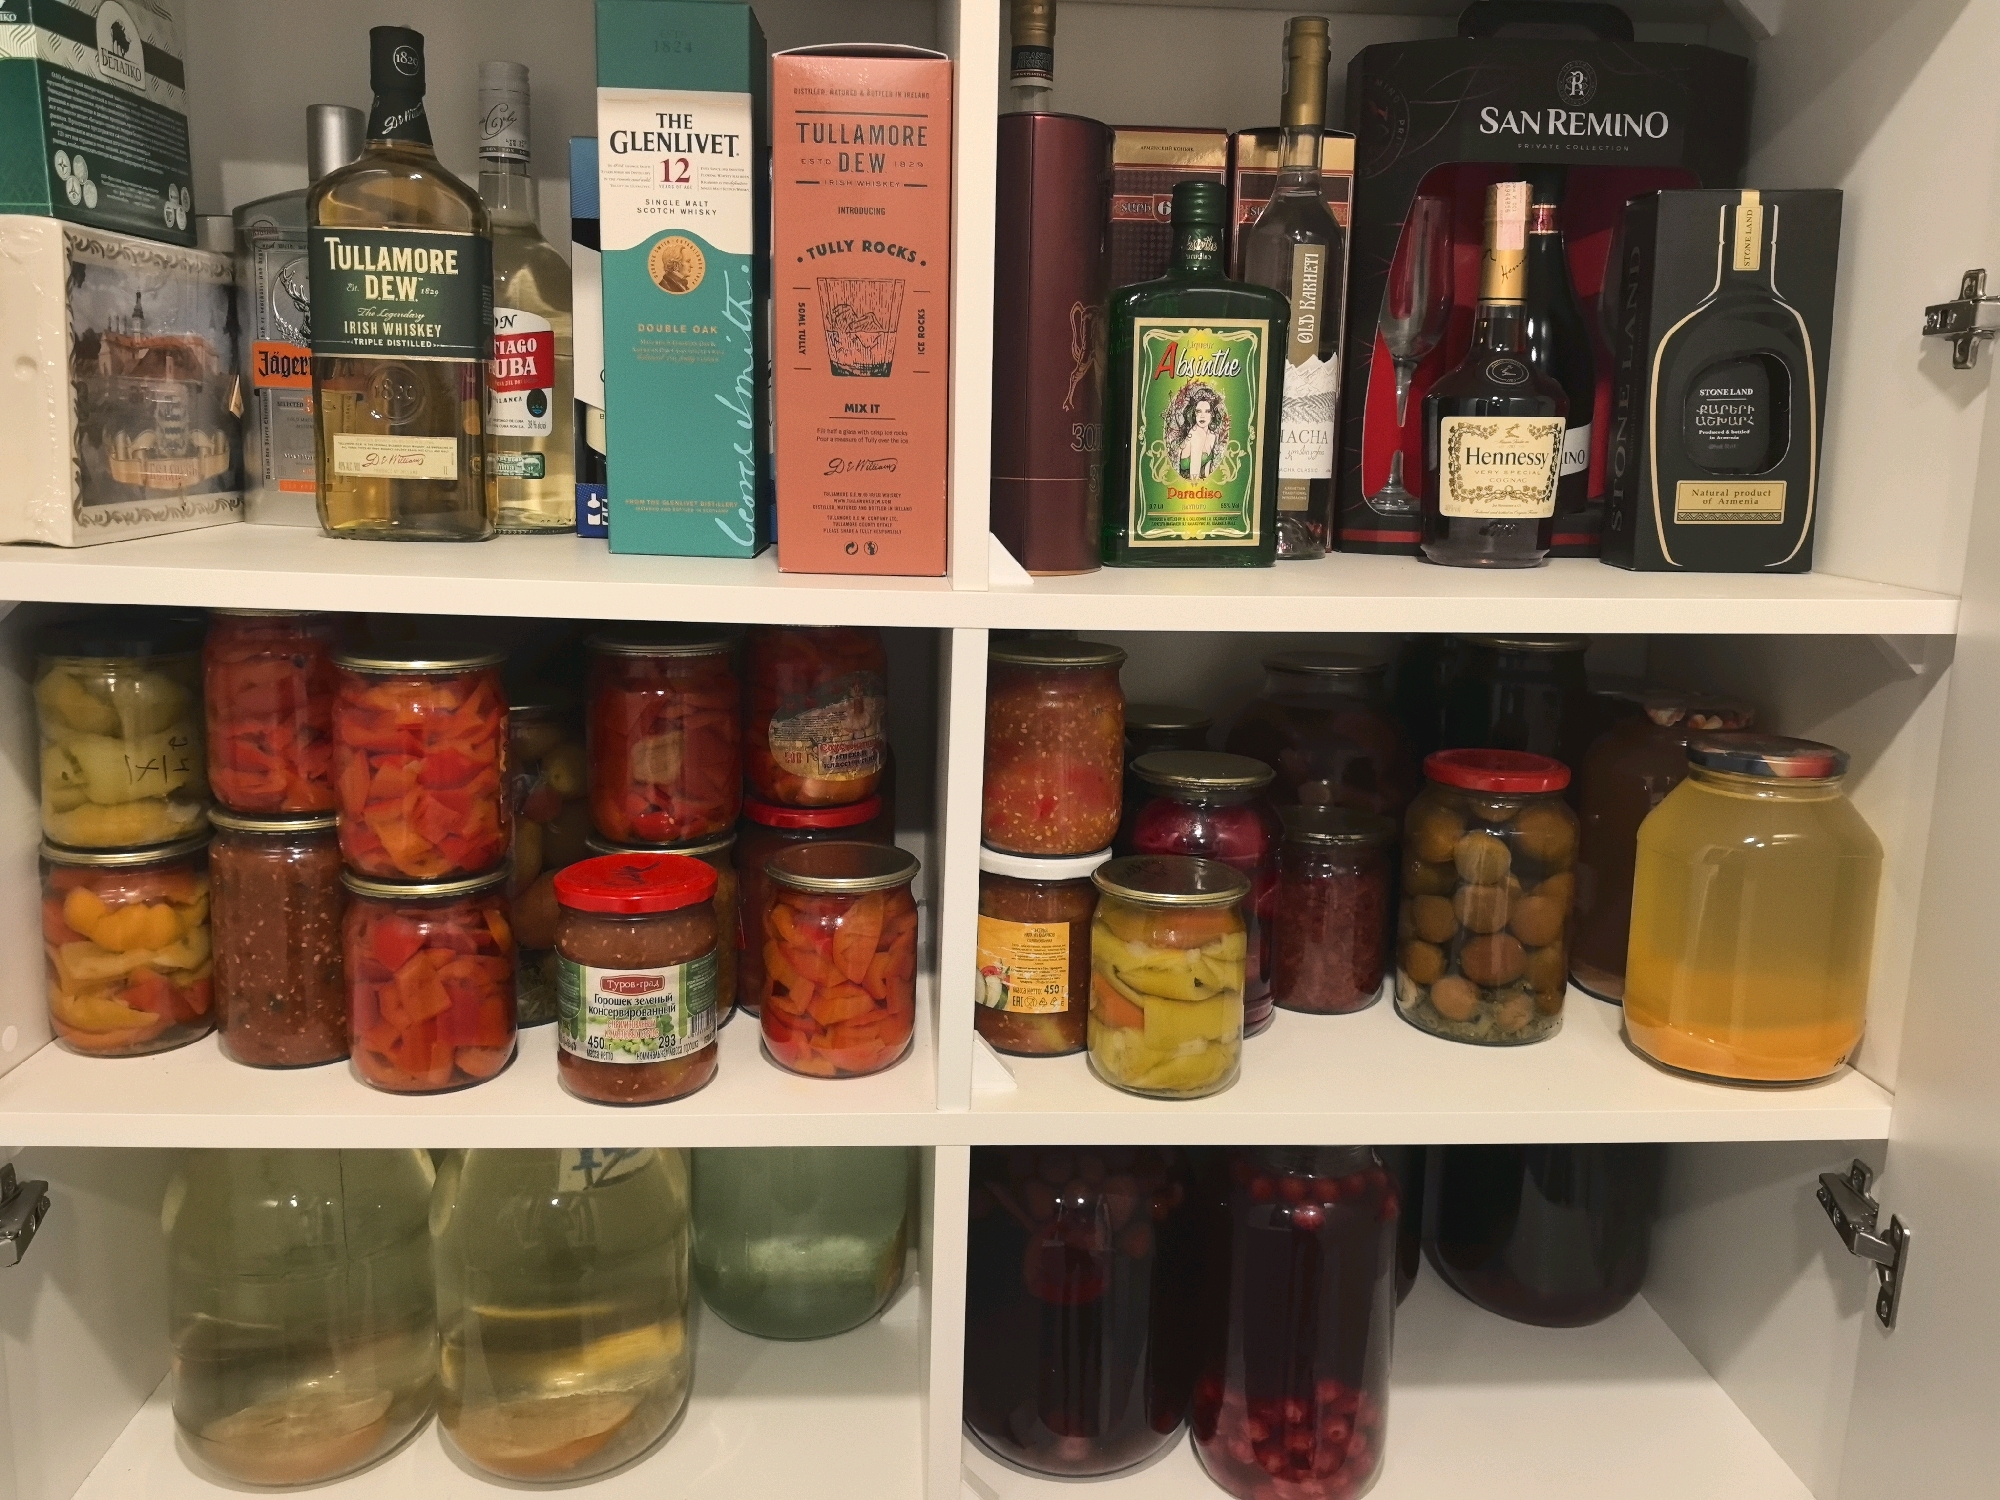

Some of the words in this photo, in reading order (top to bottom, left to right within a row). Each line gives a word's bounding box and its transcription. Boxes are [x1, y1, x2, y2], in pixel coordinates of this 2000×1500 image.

[653, 40, 693, 54] 1824
[101, 47, 142, 83] БЕЛАЛКО
[829, 88, 857, 97] MATURED
[866, 89, 893, 98] BOTTLED
[904, 91, 930, 100] IRELAND
[656, 112, 693, 130] THE
[1479, 105, 1542, 136] SAN
[1546, 107, 1669, 139] REMINO
[795, 122, 928, 147] TULLAMORE
[609, 130, 739, 158] GLENLIVET
[1565, 144, 1630, 152] COLLECTION
[660, 157, 691, 184] 12
[838, 152, 888, 174] D.E.W.
[645, 198, 680, 206] SINGLE
[685, 199, 709, 207] MALT
[637, 207, 675, 215] SCOTCH
[680, 208, 717, 216] WHISKY
[837, 206, 886, 216] INTRODUCING
[1745, 209, 1753, 236] LAND
[324, 236, 459, 275] TULLAMORE
[806, 239, 855, 260] TULLY
[862, 239, 918, 263] ROCKS
[1743, 236, 1752, 267] STONE
[1298, 252, 1319, 311] KAKHETI
[421, 287, 439, 297] 1829
[357, 306, 376, 318] The
[377, 308, 425, 323] Legendary
[797, 302, 806, 326] 50ML
[344, 321, 378, 336] IRISH
[383, 322, 442, 338] WHISKEY
[637, 323, 687, 333] DOUBLE
[692, 324, 718, 334] OAK
[917, 308, 926, 339] ROCKS
[1296, 313, 1317, 344] OLD
[354, 338, 383, 346] TRIPLE
[387, 338, 432, 348] DISTILLED
[797, 328, 806, 355] TULLY
[917, 341, 926, 355] ICE
[1186, 339, 1215, 351] Liqueur
[493, 355, 538, 378] UBA
[1154, 340, 1242, 381] Absinthe
[1611, 384, 1630, 532] STONE
[1621, 246, 1641, 370] LAND
[1699, 388, 1729, 396] STONE
[1730, 388, 1754, 396] LAND
[844, 403, 868, 414] MIX
[870, 403, 881, 414] IT
[865, 437, 878, 445] Tully
[870, 429, 884, 437] crisp
[1466, 447, 1549, 470] Hennessy
[1166, 485, 1223, 500] Paradiso
[1691, 488, 1729, 497] Natural
[1734, 488, 1771, 498] product
[662, 499, 698, 507] GLENLIVET
[1702, 497, 1713, 505] of
[1718, 497, 1759, 505] Armenia
[1012, 986, 1027, 994] масса
[1044, 984, 1060, 995] 450
[594, 994, 633, 1009] Горошек
[634, 993, 673, 1008] зеленый
[588, 1003, 677, 1021] консервированный
[588, 1034, 605, 1050] 450
[658, 1033, 677, 1049] 293
[586, 1049, 599, 1060] масса
[600, 1051, 614, 1061] нетто
